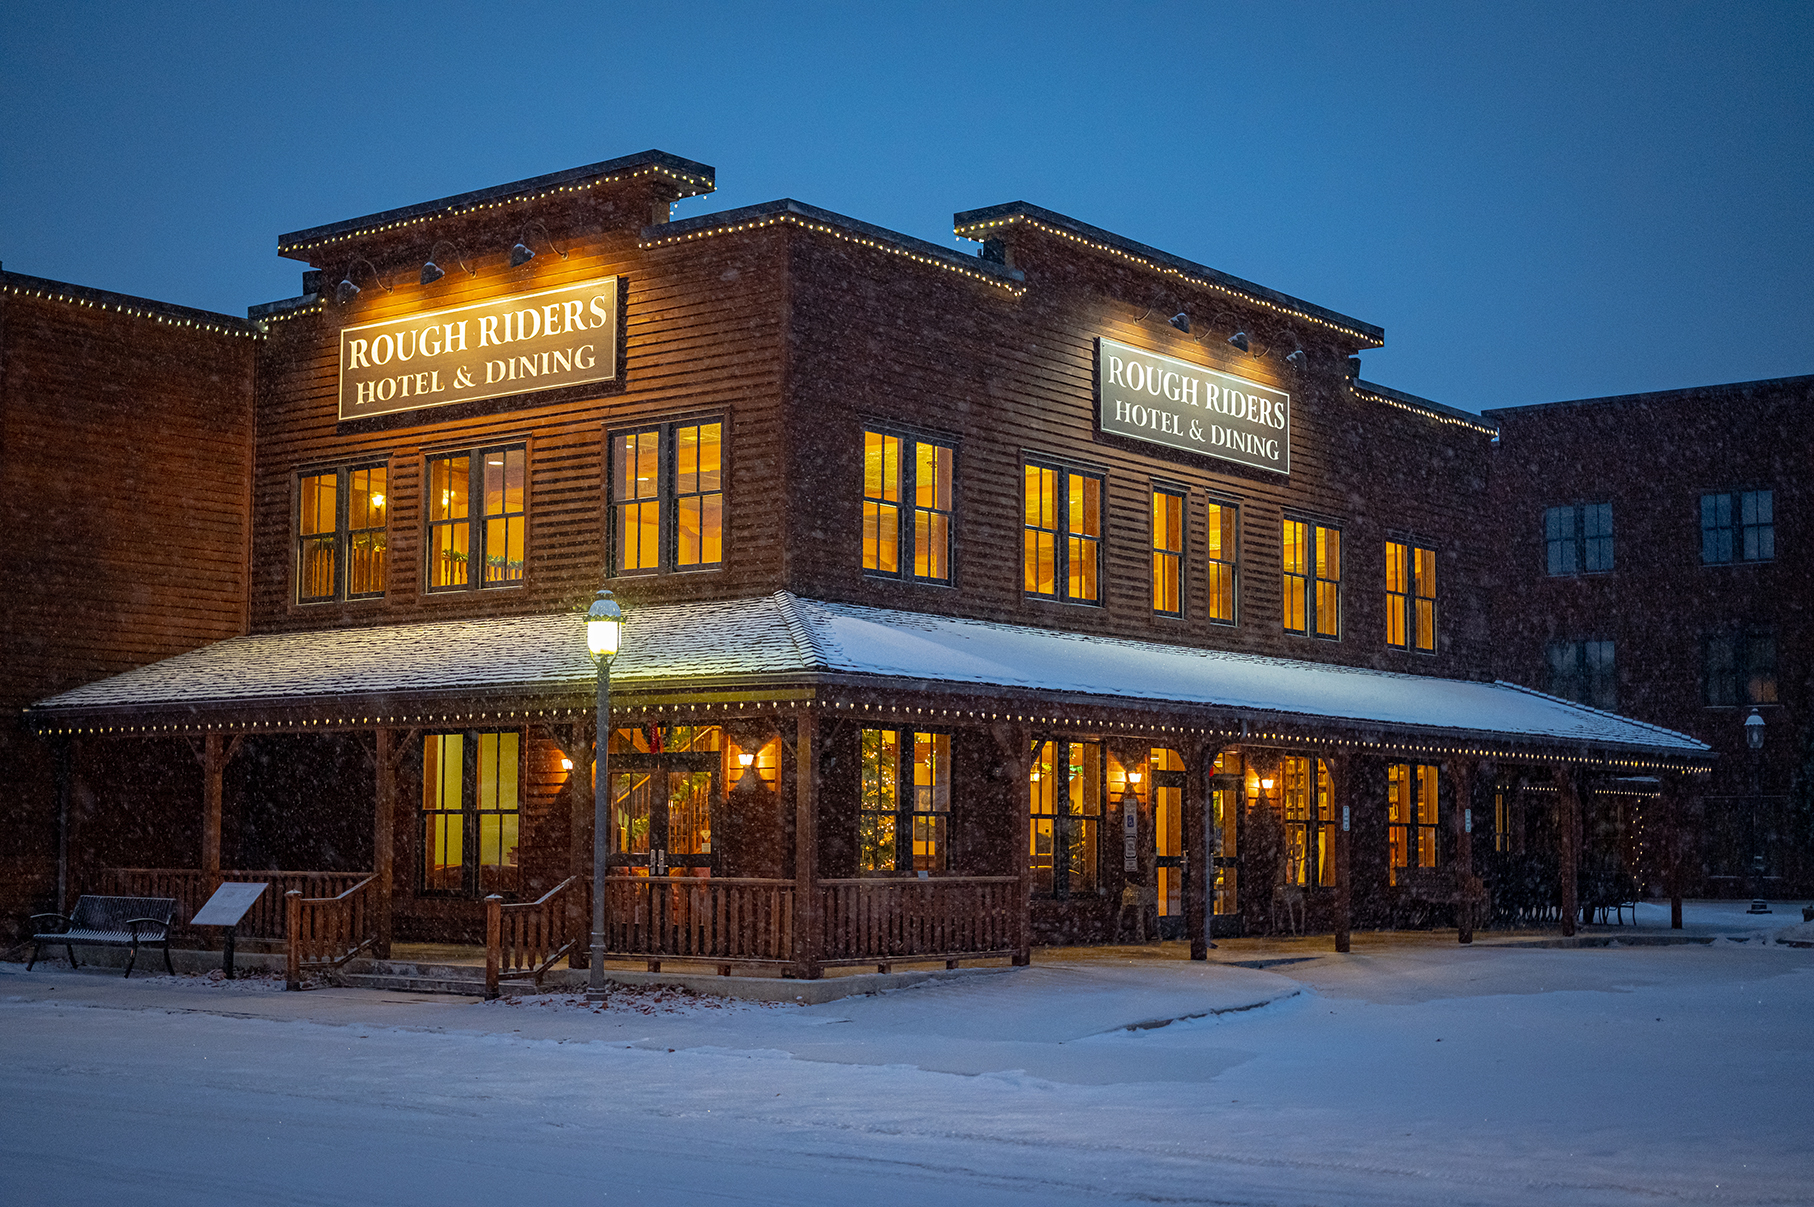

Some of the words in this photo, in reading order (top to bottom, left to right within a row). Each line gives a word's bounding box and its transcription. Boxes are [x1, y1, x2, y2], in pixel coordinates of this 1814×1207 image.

[348, 320, 468, 370] ROUGH
[478, 294, 607, 348] RIDERS
[356, 370, 445, 405] HOTEL
[452, 365, 476, 390] &
[484, 344, 596, 384] DINING
[1108, 355, 1199, 406] ROUGH
[1205, 381, 1285, 430] RIDERS
[1115, 400, 1184, 436] HOTEL
[1189, 418, 1205, 442] &
[1211, 424, 1279, 461] DINING
